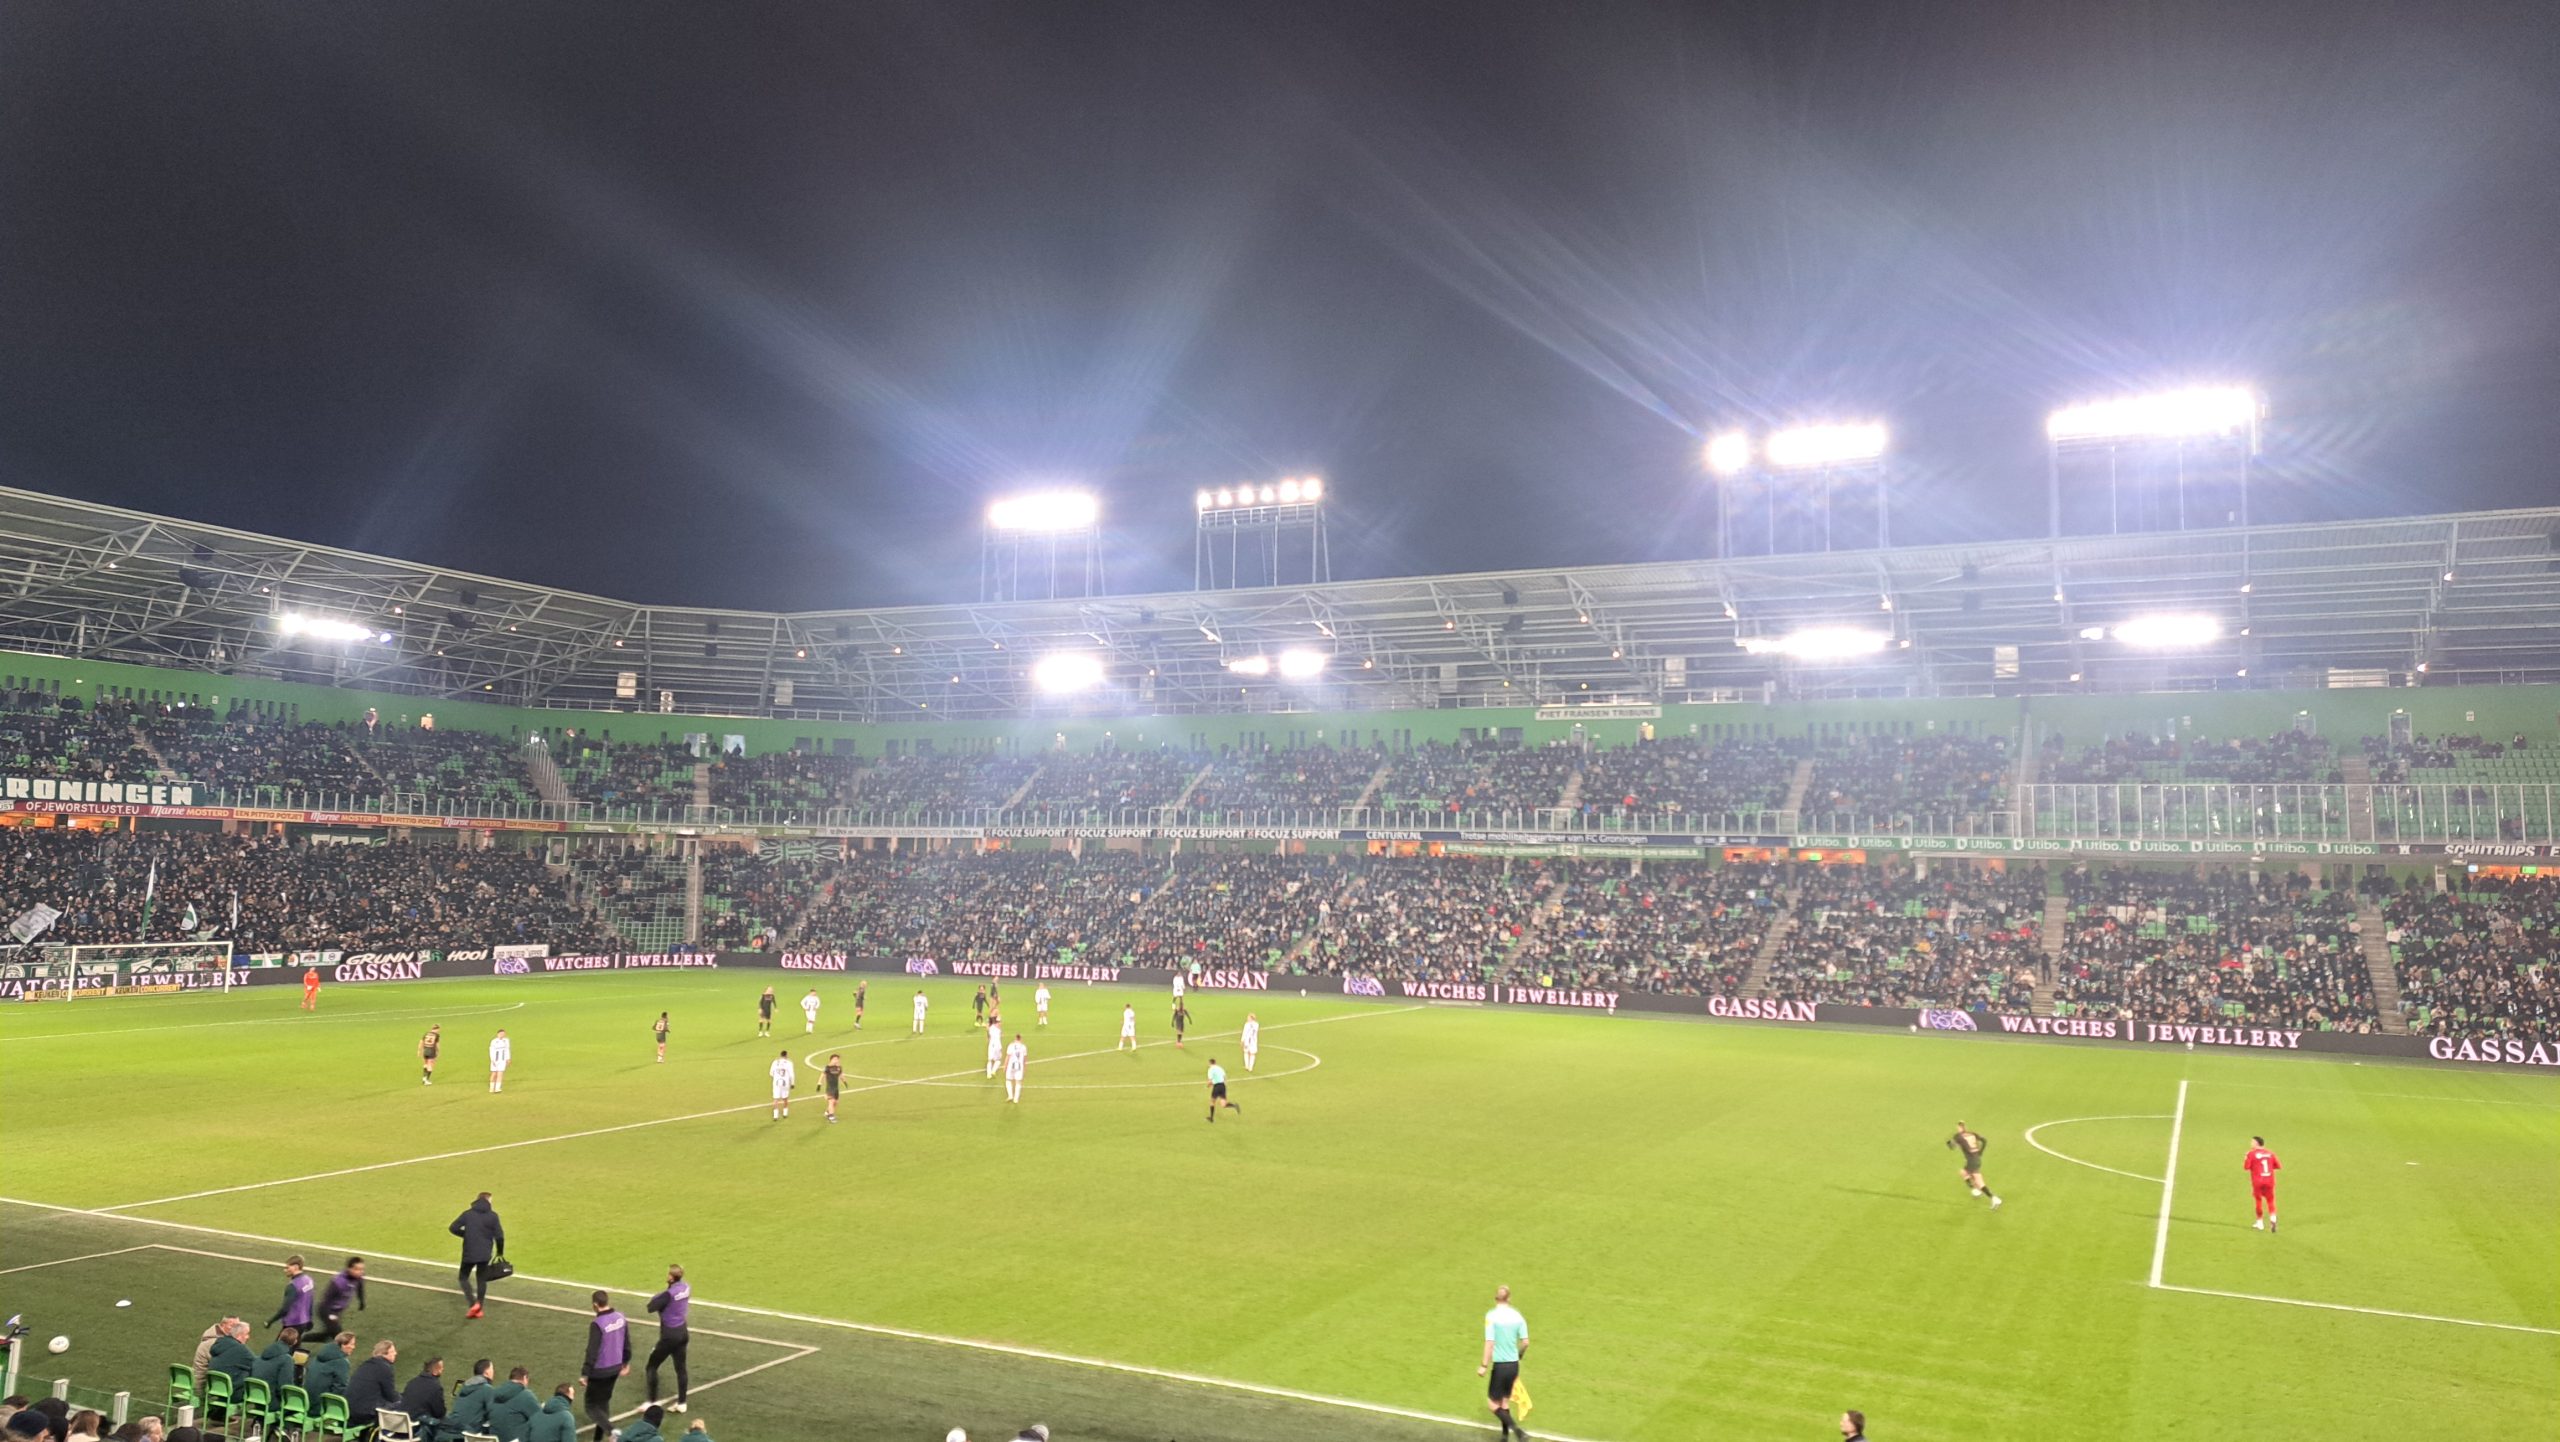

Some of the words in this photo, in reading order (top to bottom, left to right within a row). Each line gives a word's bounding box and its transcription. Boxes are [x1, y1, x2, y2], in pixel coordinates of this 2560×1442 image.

[0, 777, 192, 806] RONINGEN
[26, 801, 140, 814] OFJEWORSTLUST.EU
[151, 805, 185, 817] Marne
[186, 808, 229, 817] MOSTERD
[310, 812, 340, 823] Marne
[341, 814, 378, 823] MOSTERD
[991, 829, 1022, 838] FOCUZ
[1023, 829, 1066, 838] SUPPORT
[1074, 829, 1106, 838] FOCUZ
[1107, 829, 1152, 838] SUPPORT
[1163, 830, 1197, 839] FOCUZ
[1199, 830, 1246, 839] SUPPORT
[1254, 830, 1290, 839] FOCUZ
[1291, 830, 1340, 839] SUPPORT
[1585, 835, 1598, 843] FC
[346, 951, 415, 965] GRUNN
[544, 956, 609, 971] WATCHES
[625, 954, 716, 968] JEWELLERY
[781, 953, 847, 970] GASSAN
[335, 962, 423, 982] GASSAN
[952, 962, 1018, 977] WATCHES
[1035, 965, 1121, 981] JEWELLERY
[1402, 982, 1486, 1000] WATCHES
[1508, 988, 1620, 1008] JEWELLERY
[1708, 996, 1818, 1021] GASSAN
[2000, 1016, 2117, 1038] WATCHES
[2147, 1024, 2301, 1049] JEWELLERY
[2260, 1159, 2271, 1177] 1
